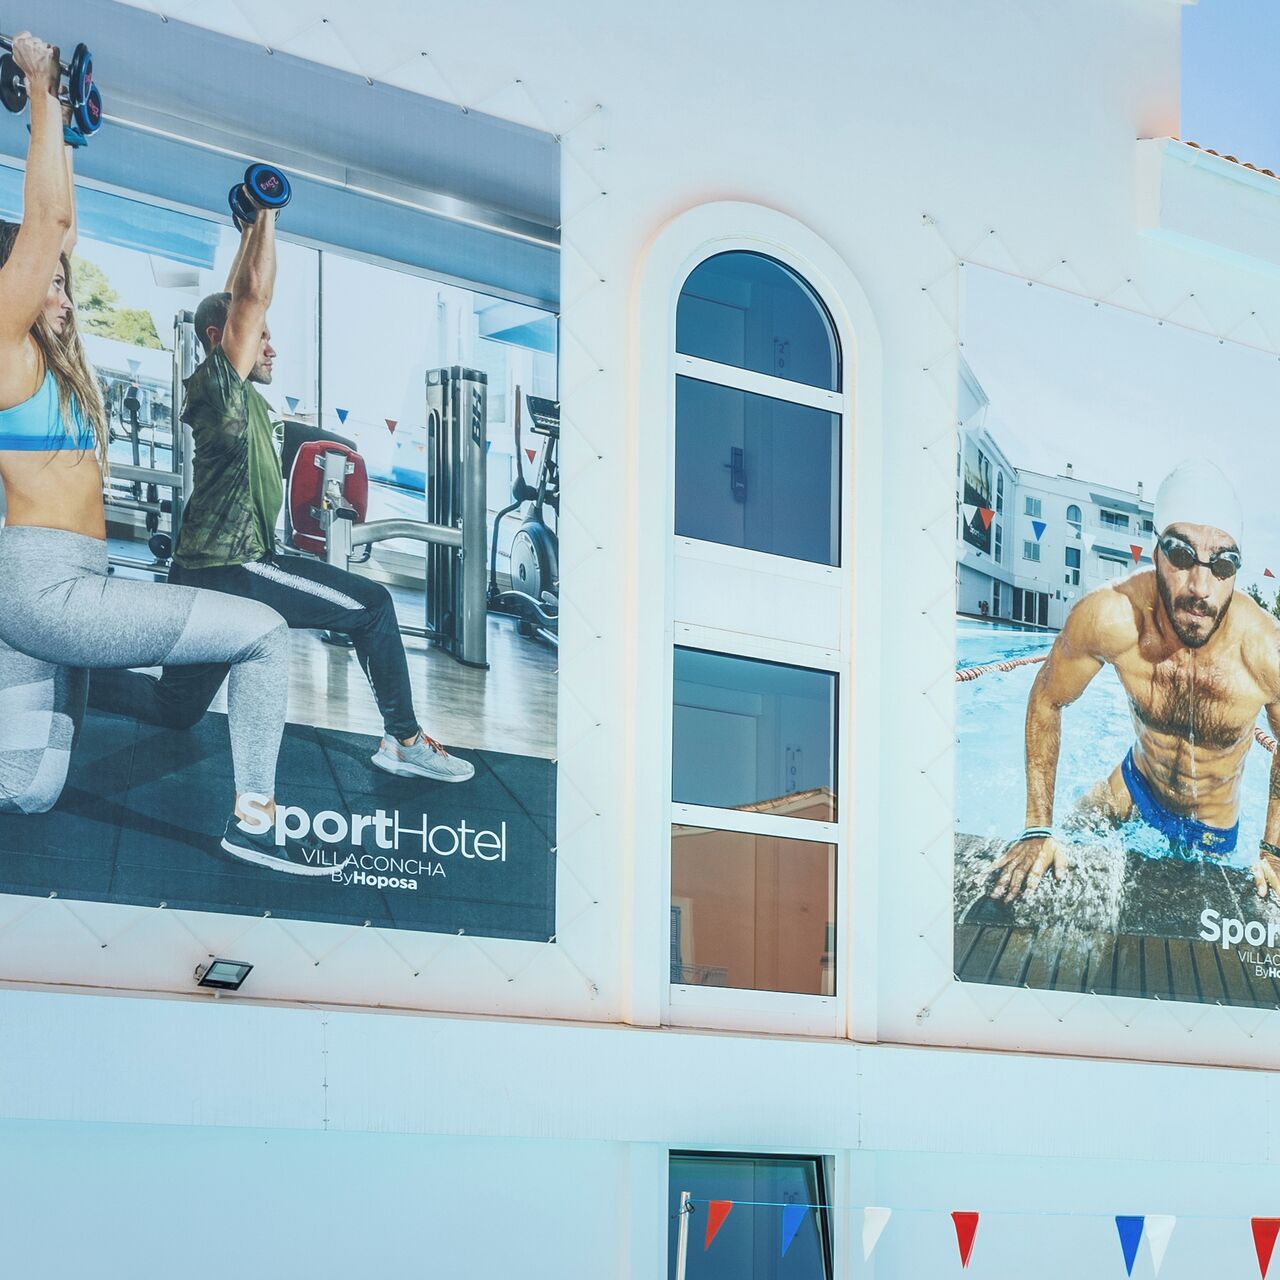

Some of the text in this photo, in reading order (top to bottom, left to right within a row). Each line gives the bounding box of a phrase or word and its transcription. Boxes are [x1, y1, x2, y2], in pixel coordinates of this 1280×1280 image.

[472, 387, 481, 448] BH
[236, 792, 506, 862] SportHotel
[301, 848, 446, 877] VILLACONCHA
